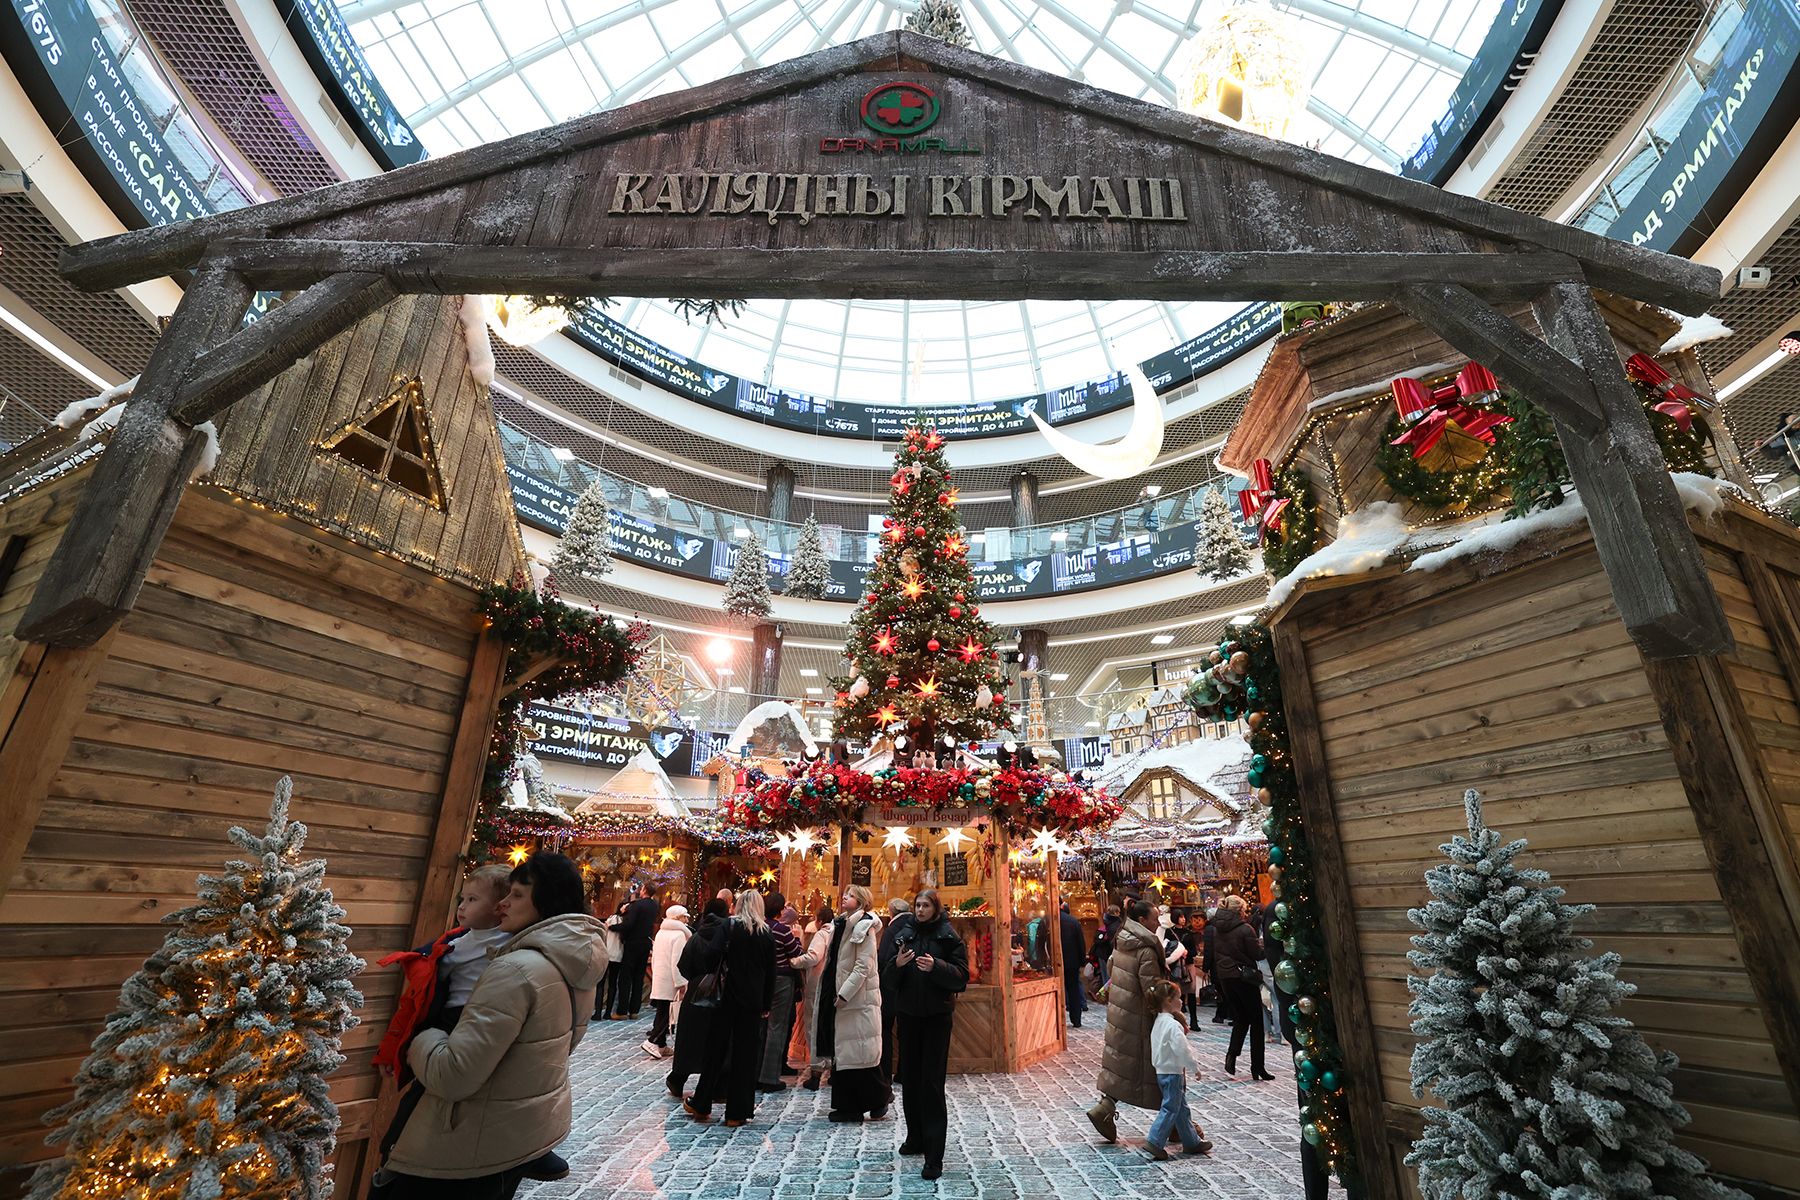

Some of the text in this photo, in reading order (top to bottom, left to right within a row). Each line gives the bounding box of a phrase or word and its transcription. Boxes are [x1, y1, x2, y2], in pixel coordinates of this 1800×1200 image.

[341, 31, 373, 81] КВАРТИР
[91, 36, 122, 88] СТАРТ
[119, 88, 164, 158] ПРОДАЖ
[344, 81, 361, 106] ДО
[361, 107, 369, 119] 4
[369, 120, 390, 147] ЛЕТ
[87, 74, 181, 220] В ДОМЕ «САД
[1660, 48, 1764, 213] ЭРМИТАЖ»
[84, 111, 160, 217] РАССРОЧКА ОТ
[607, 172, 1188, 226] КАЛЯДНЫ КІРМАШ
[586, 318, 702, 383] «САД ЭРМИТАЖ»
[1174, 342, 1196, 356] СТАРТ
[1197, 324, 1227, 345] ПРОДАЖ
[1189, 346, 1211, 361] ДОМЕ
[1213, 320, 1251, 347] «САД
[1191, 344, 1233, 370] РАССРОЧКА
[1234, 338, 1243, 347] ОТ
[603, 341, 613, 353] ОТ
[613, 348, 666, 380] ЗАСТРОЙЩИКА
[669, 375, 684, 387] ДО
[693, 385, 713, 398] ЛЕТ
[1151, 373, 1172, 388] 675
[834, 421, 859, 431] 7675
[900, 416, 936, 428] «СД
[938, 411, 1012, 427] ЭРМИТАЖ»
[919, 408, 966, 416] -УРОВНЕВЫХ
[982, 423, 997, 432] ДО
[1006, 419, 1025, 429] ЛЕТ
[505, 466, 526, 481] ТАРТ
[526, 476, 563, 498] ПРОДАЖ
[622, 518, 657, 533] КВАРТИР
[512, 485, 538, 502] ДОМЕ
[514, 501, 559, 527] АССРОЧКА
[634, 547, 652, 559] ДО
[653, 552, 662, 562] 4
[662, 556, 684, 568] ЛЕТ
[1163, 550, 1192, 567] 7675
[981, 584, 1027, 596] ДО 4 ЛЕТ
[591, 720, 631, 733] КВАРТИР
[534, 742, 602, 761] ЗАСТРОЙЩИКА
[606, 752, 625, 764] ДО
